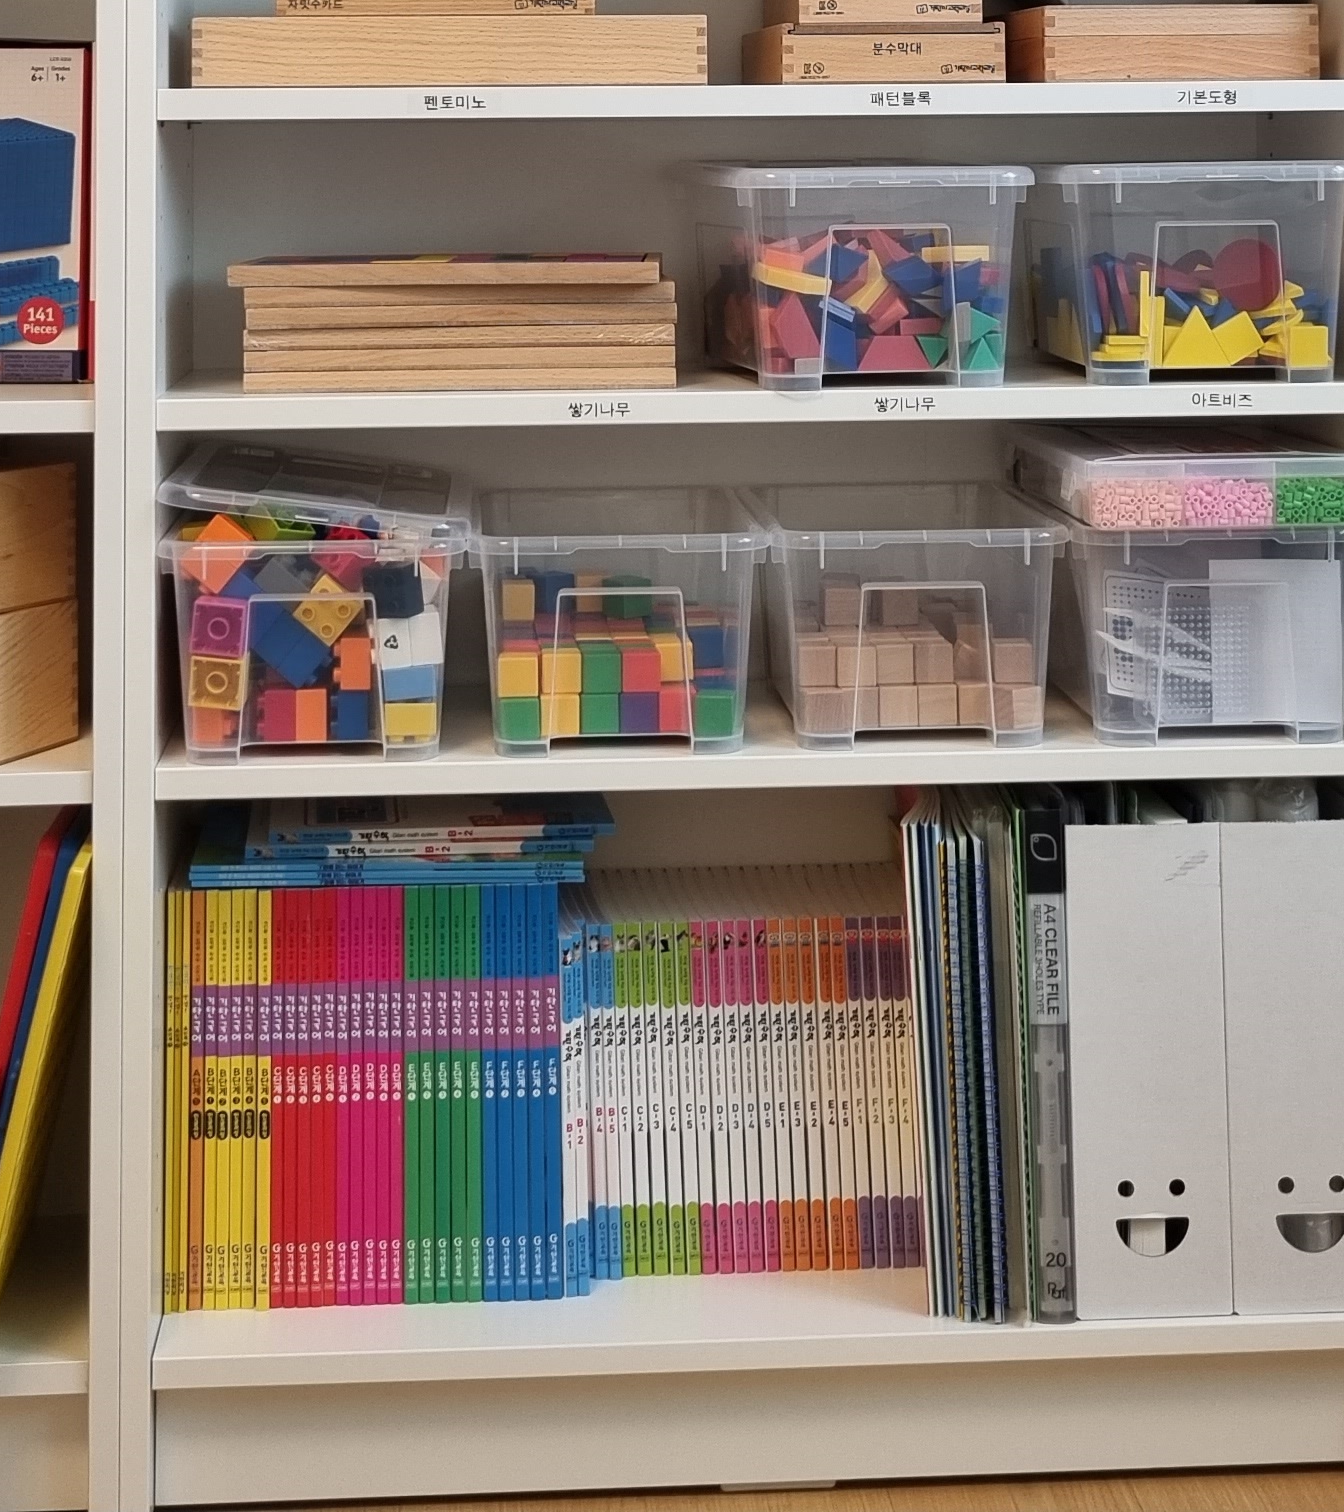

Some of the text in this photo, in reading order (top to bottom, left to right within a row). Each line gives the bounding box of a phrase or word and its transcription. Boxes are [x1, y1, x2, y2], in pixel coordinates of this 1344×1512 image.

[872, 42, 922, 55] 분수막대
[424, 95, 487, 111] 펜토미노
[871, 90, 932, 107] 패턴블록
[1177, 89, 1238, 106] 기본도형
[26, 307, 55, 322] 141
[24, 324, 57, 335] Pieces
[568, 400, 630, 418] 쌓기나무
[874, 396, 936, 413] 쌓기나무
[1191, 392, 1253, 409] 아트비즈
[1044, 904, 1060, 1016] A4 CLEAR FILE
[1036, 993, 1045, 1015] TYPE
[1045, 1252, 1067, 1269] 20
